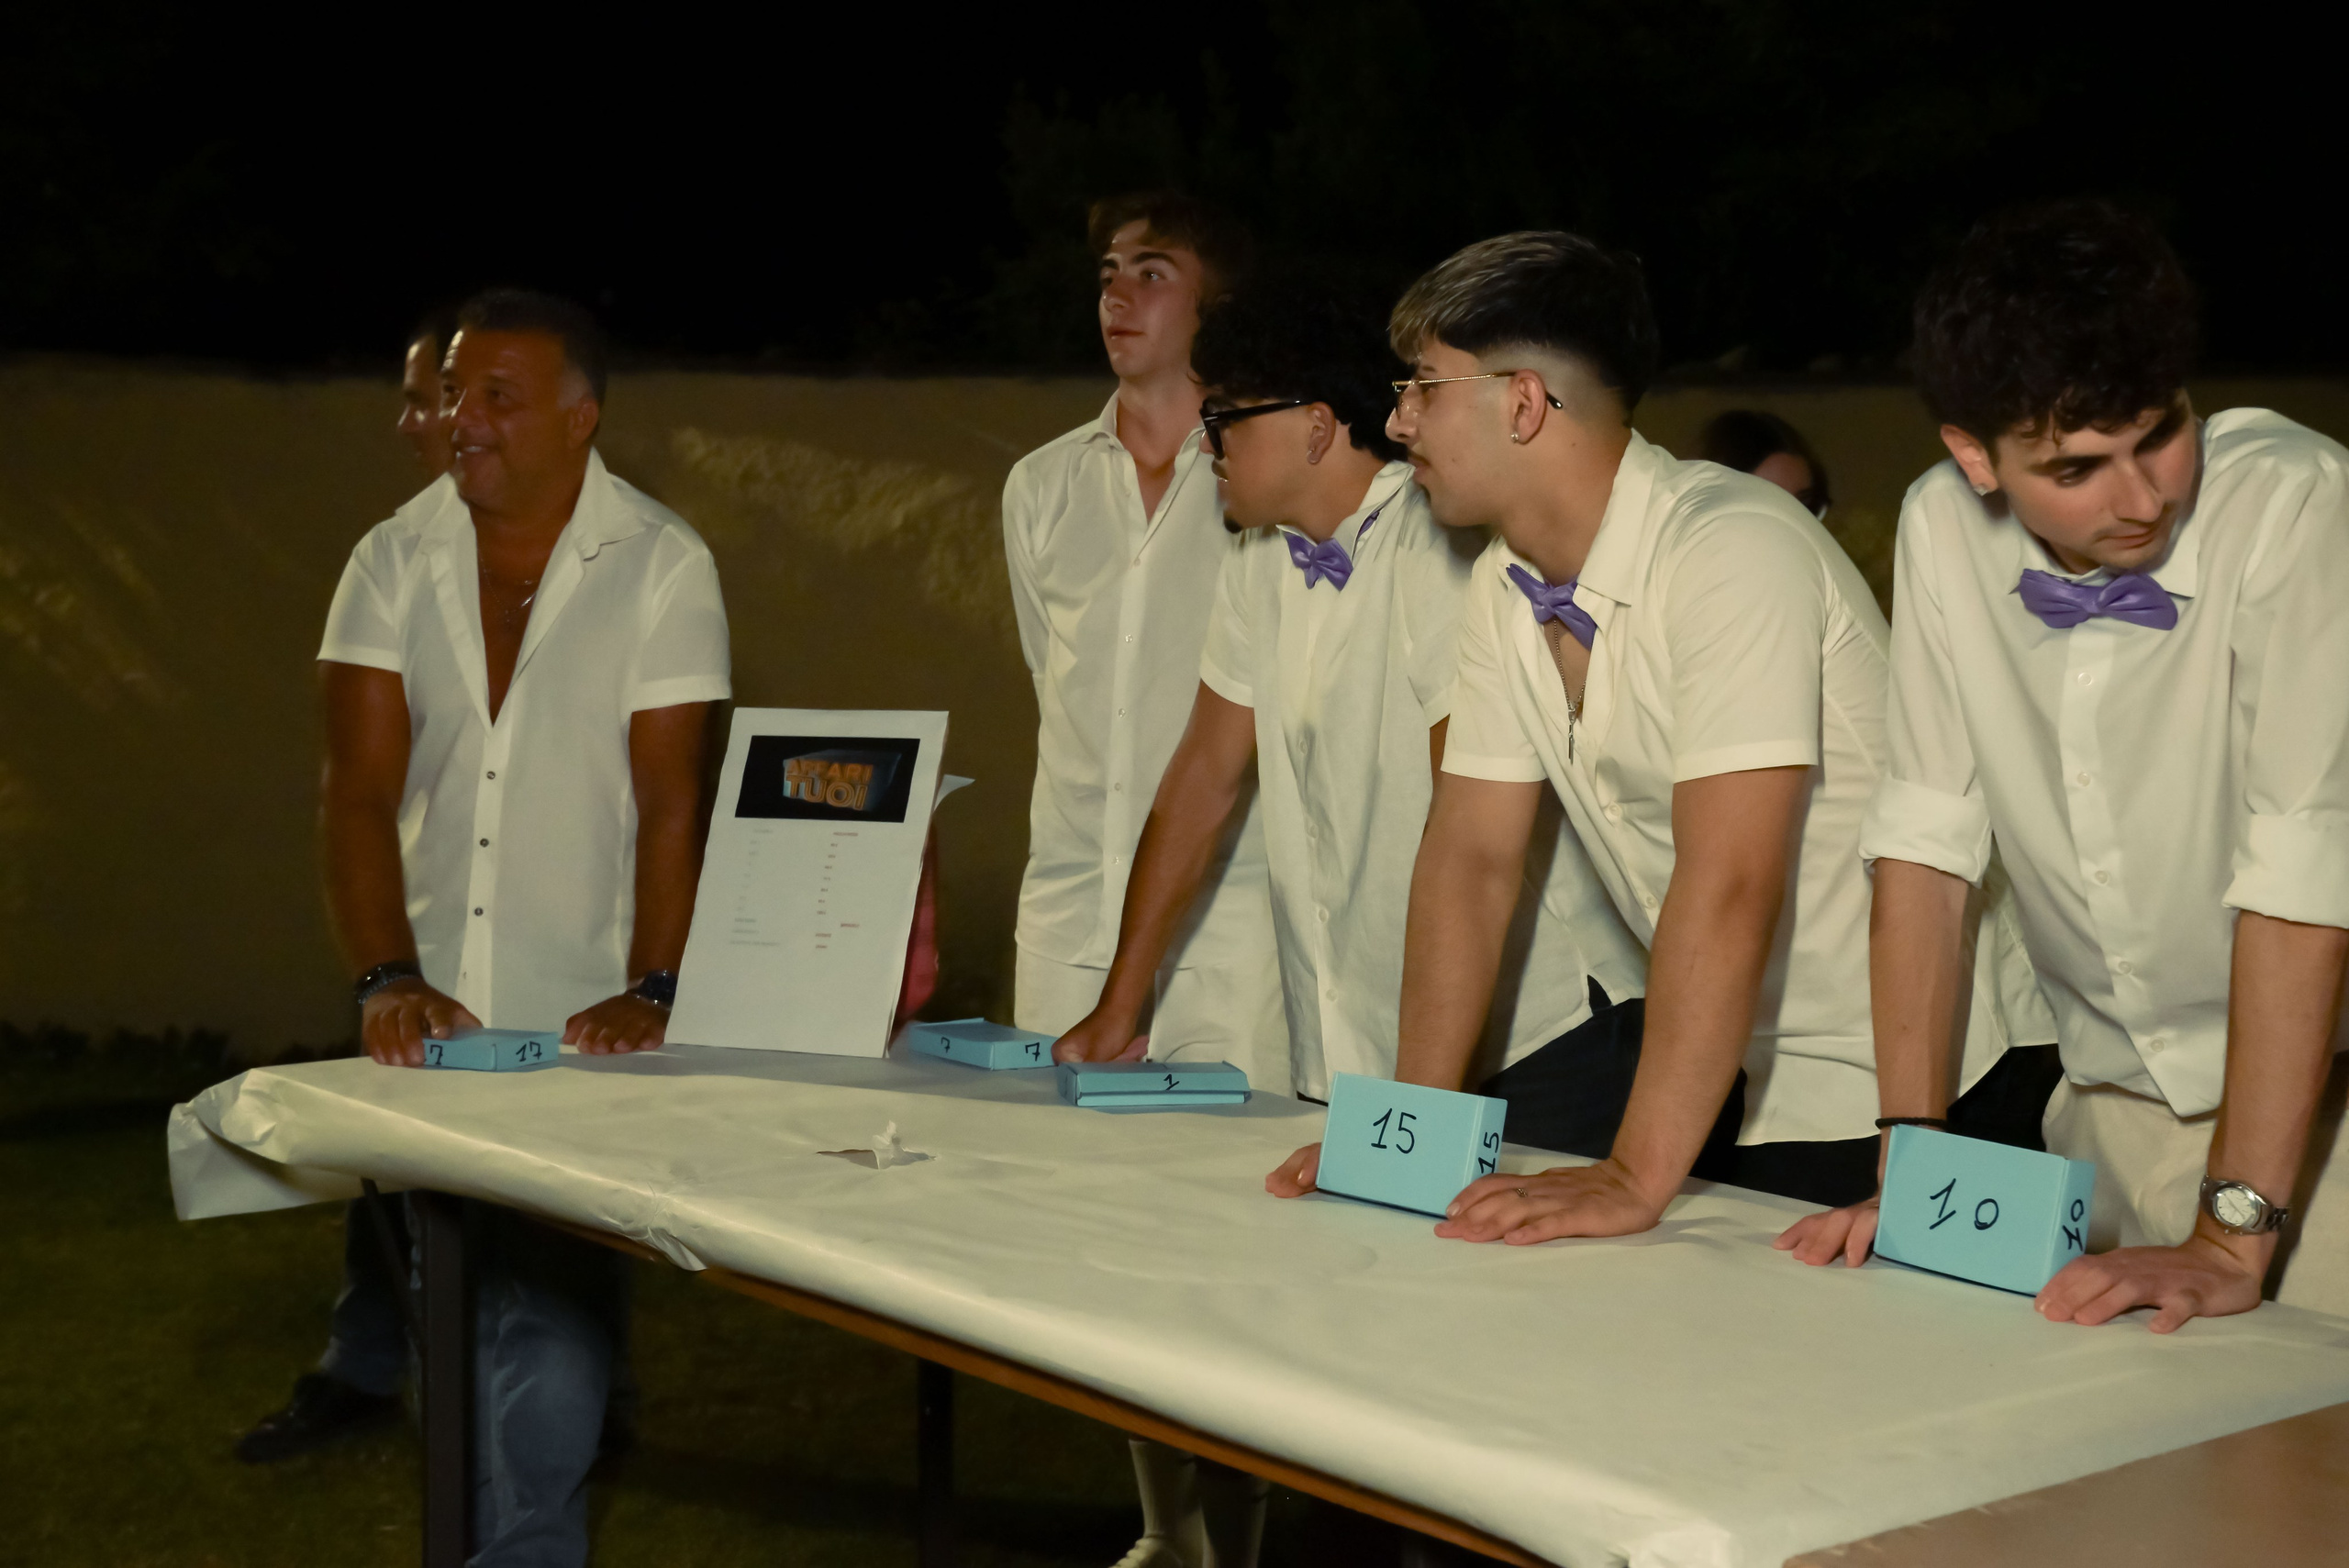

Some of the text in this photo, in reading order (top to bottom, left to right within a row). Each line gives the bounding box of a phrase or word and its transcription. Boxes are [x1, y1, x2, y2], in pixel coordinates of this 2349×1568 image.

[786, 759, 874, 783] AFFARI
[785, 774, 869, 811] TUOI
[423, 1044, 444, 1065] 7
[515, 1040, 543, 1062] 17
[941, 1036, 952, 1054] 7
[1025, 1041, 1041, 1062] 7
[1163, 1073, 1181, 1092] 1
[1370, 1107, 1418, 1155] 15
[1477, 1130, 1500, 1174] 15
[1929, 1177, 2000, 1231] 10
[2062, 1198, 2085, 1252] 10
